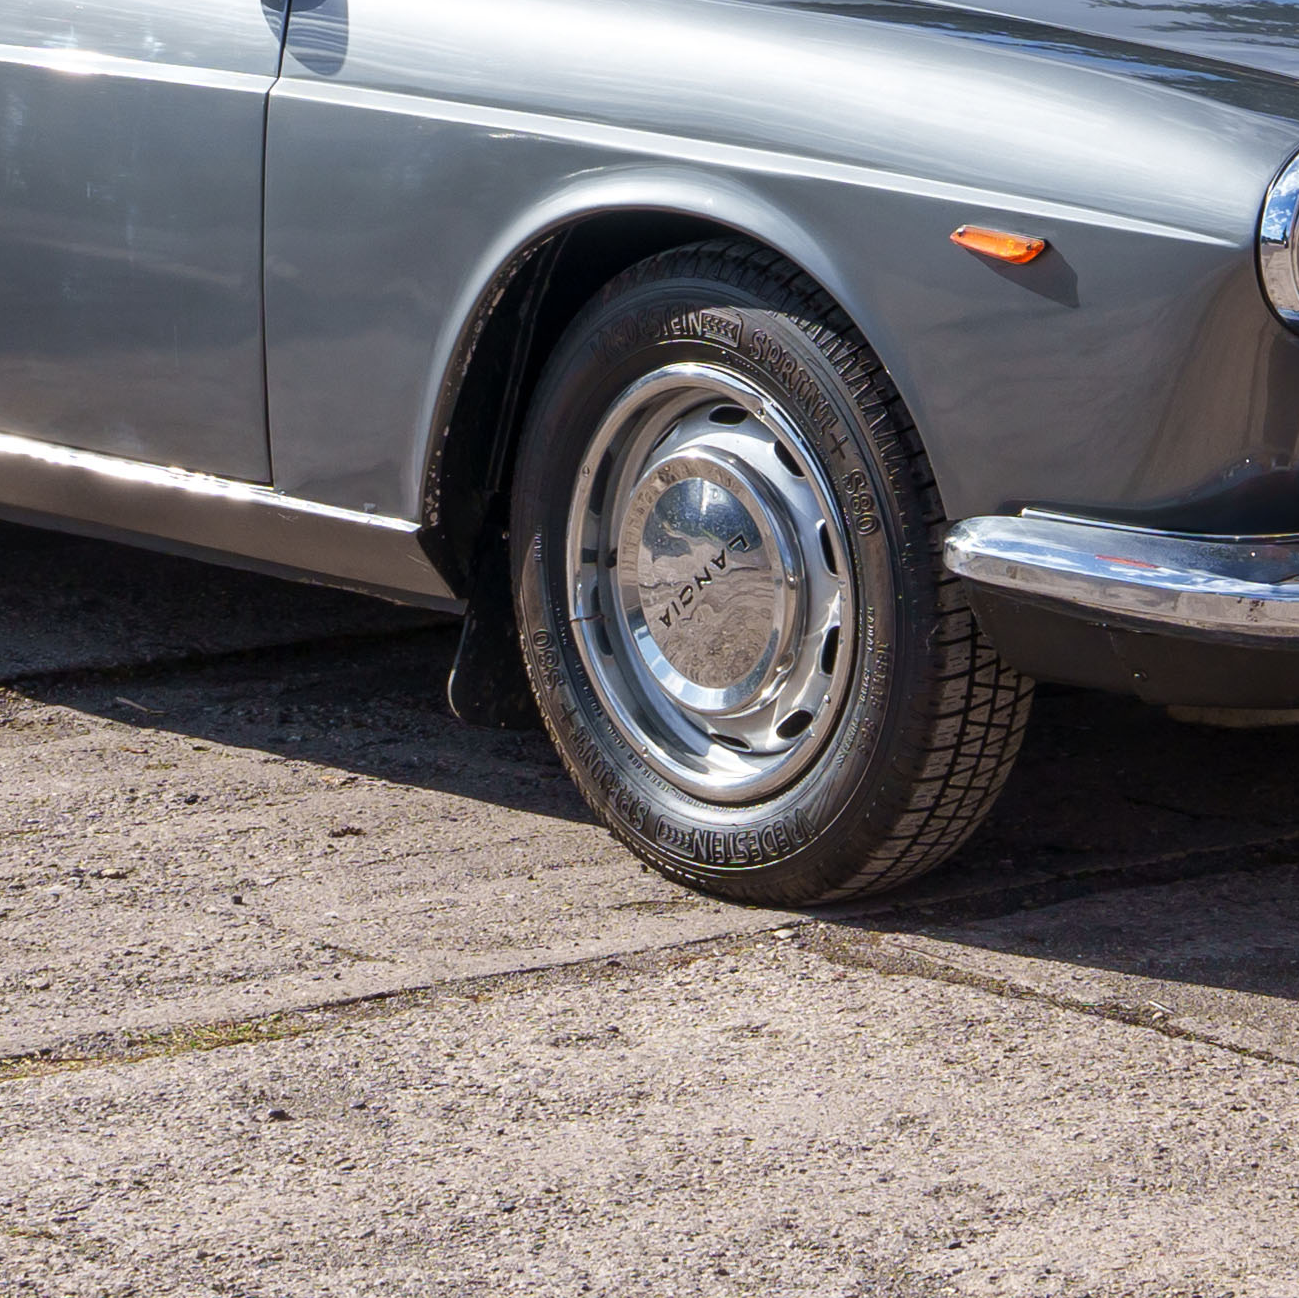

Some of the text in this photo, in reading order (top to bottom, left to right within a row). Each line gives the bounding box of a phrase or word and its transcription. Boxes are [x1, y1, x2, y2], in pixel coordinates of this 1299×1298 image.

[842, 469, 878, 536] S80
[658, 533, 750, 629] LANCIA
[532, 628, 565, 690] S80
[690, 808, 816, 866] VREDESTEIN
